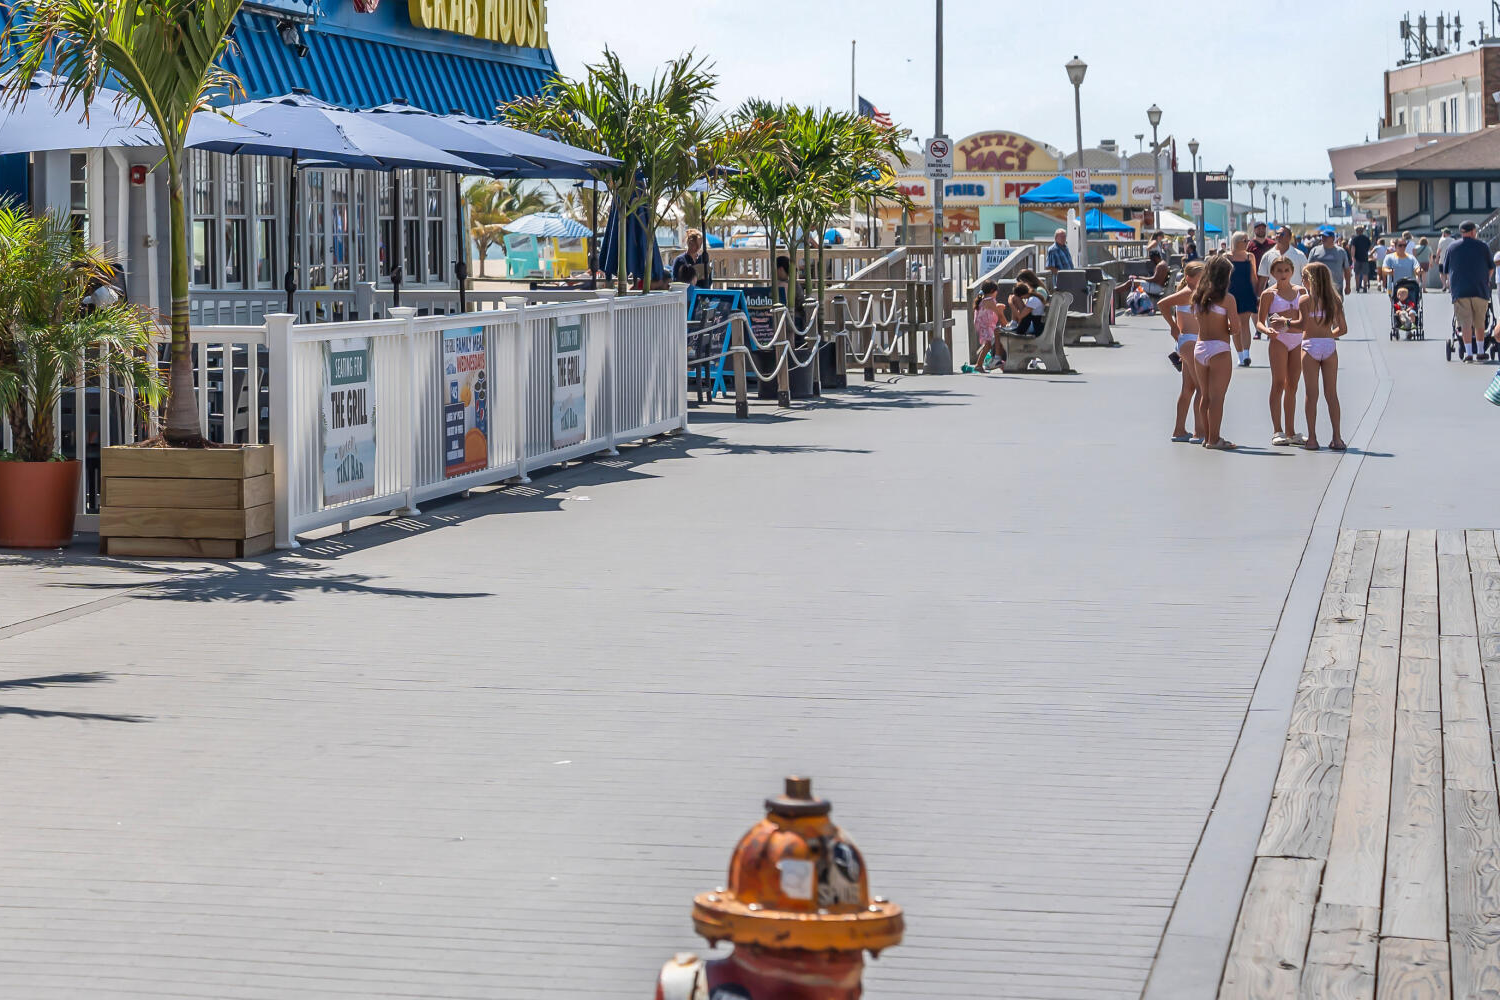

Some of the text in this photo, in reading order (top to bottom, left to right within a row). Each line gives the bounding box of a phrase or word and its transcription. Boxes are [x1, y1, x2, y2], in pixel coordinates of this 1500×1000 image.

[959, 134, 1035, 156] LITTLE
[1075, 170, 1086, 178] NO
[945, 184, 985, 197] FRIES
[335, 356, 363, 379] SEATING FOR
[557, 357, 566, 387] THE
[331, 388, 367, 429] THE GRILL
[337, 454, 364, 484] TIKI BAR
